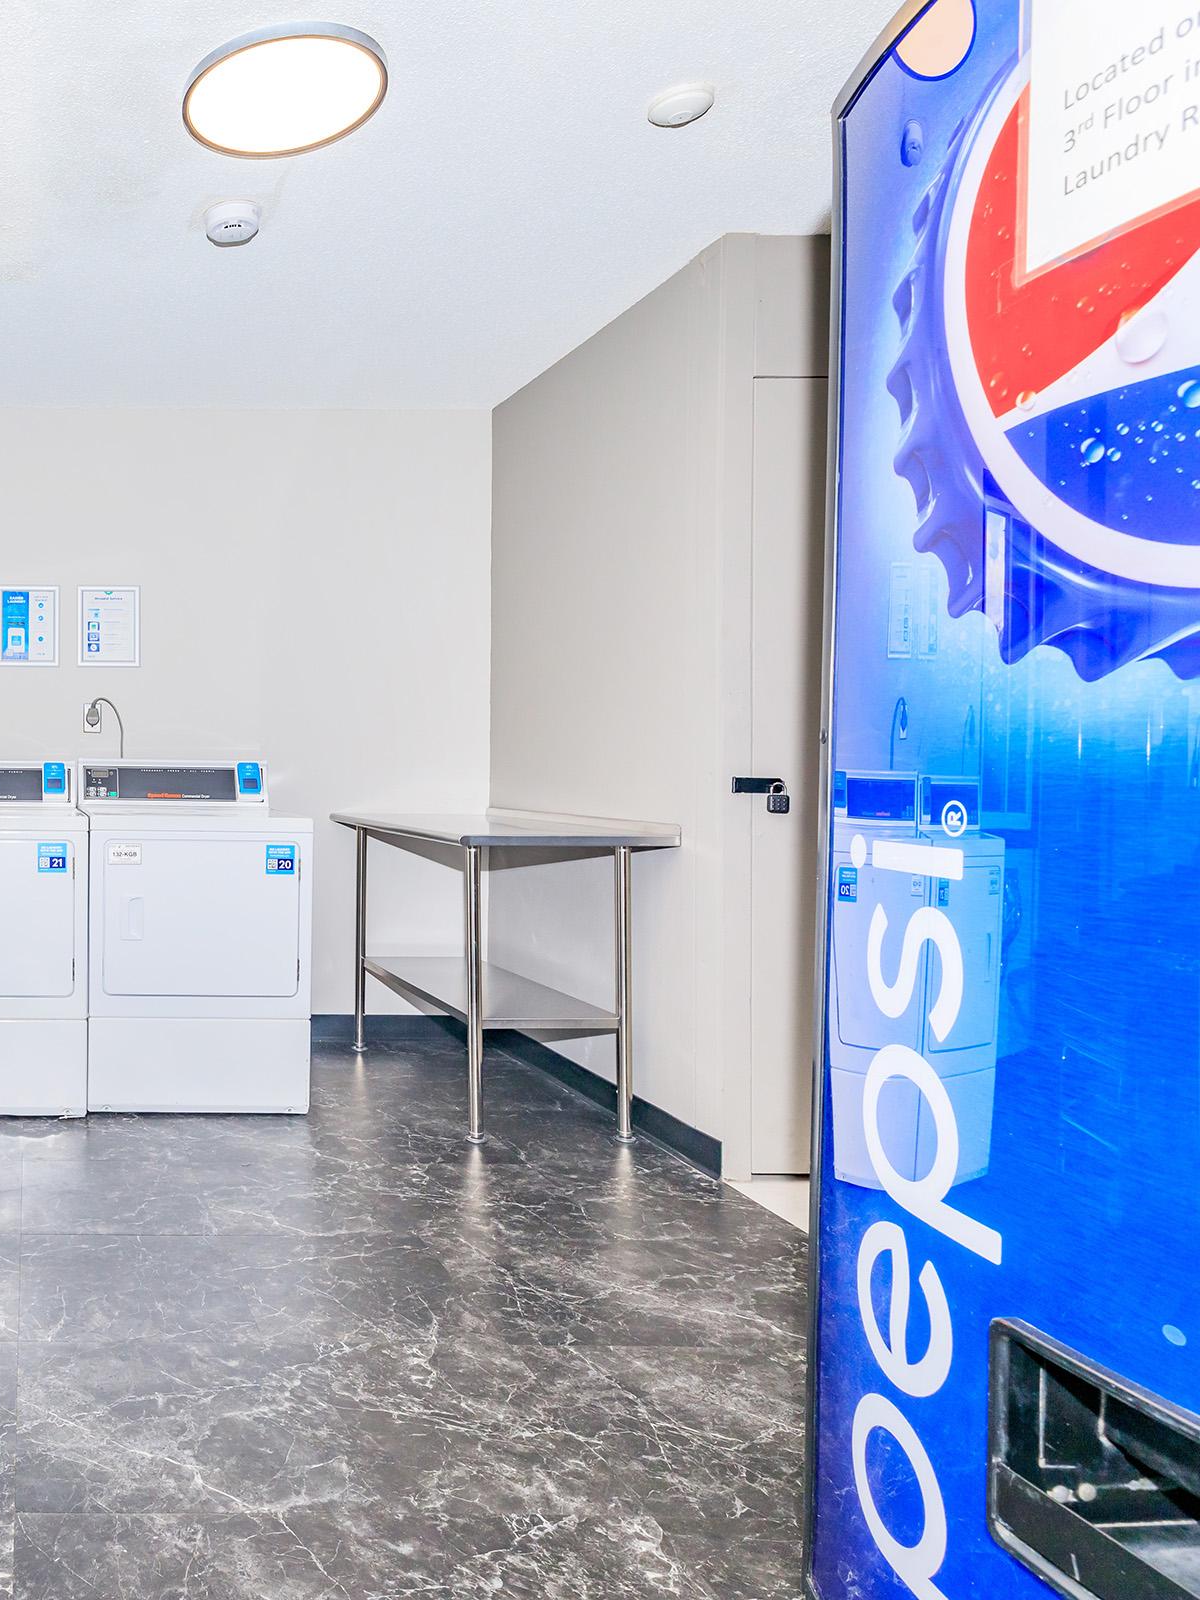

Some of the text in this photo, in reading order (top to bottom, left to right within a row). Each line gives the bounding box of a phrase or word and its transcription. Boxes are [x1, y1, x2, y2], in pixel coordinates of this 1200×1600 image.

[1064, 26, 1164, 110] Located
[1104, 74, 1174, 129] Floor
[1064, 124, 1170, 195] Laundry
[52, 858, 63, 868] 21
[279, 860, 292, 869] 20
